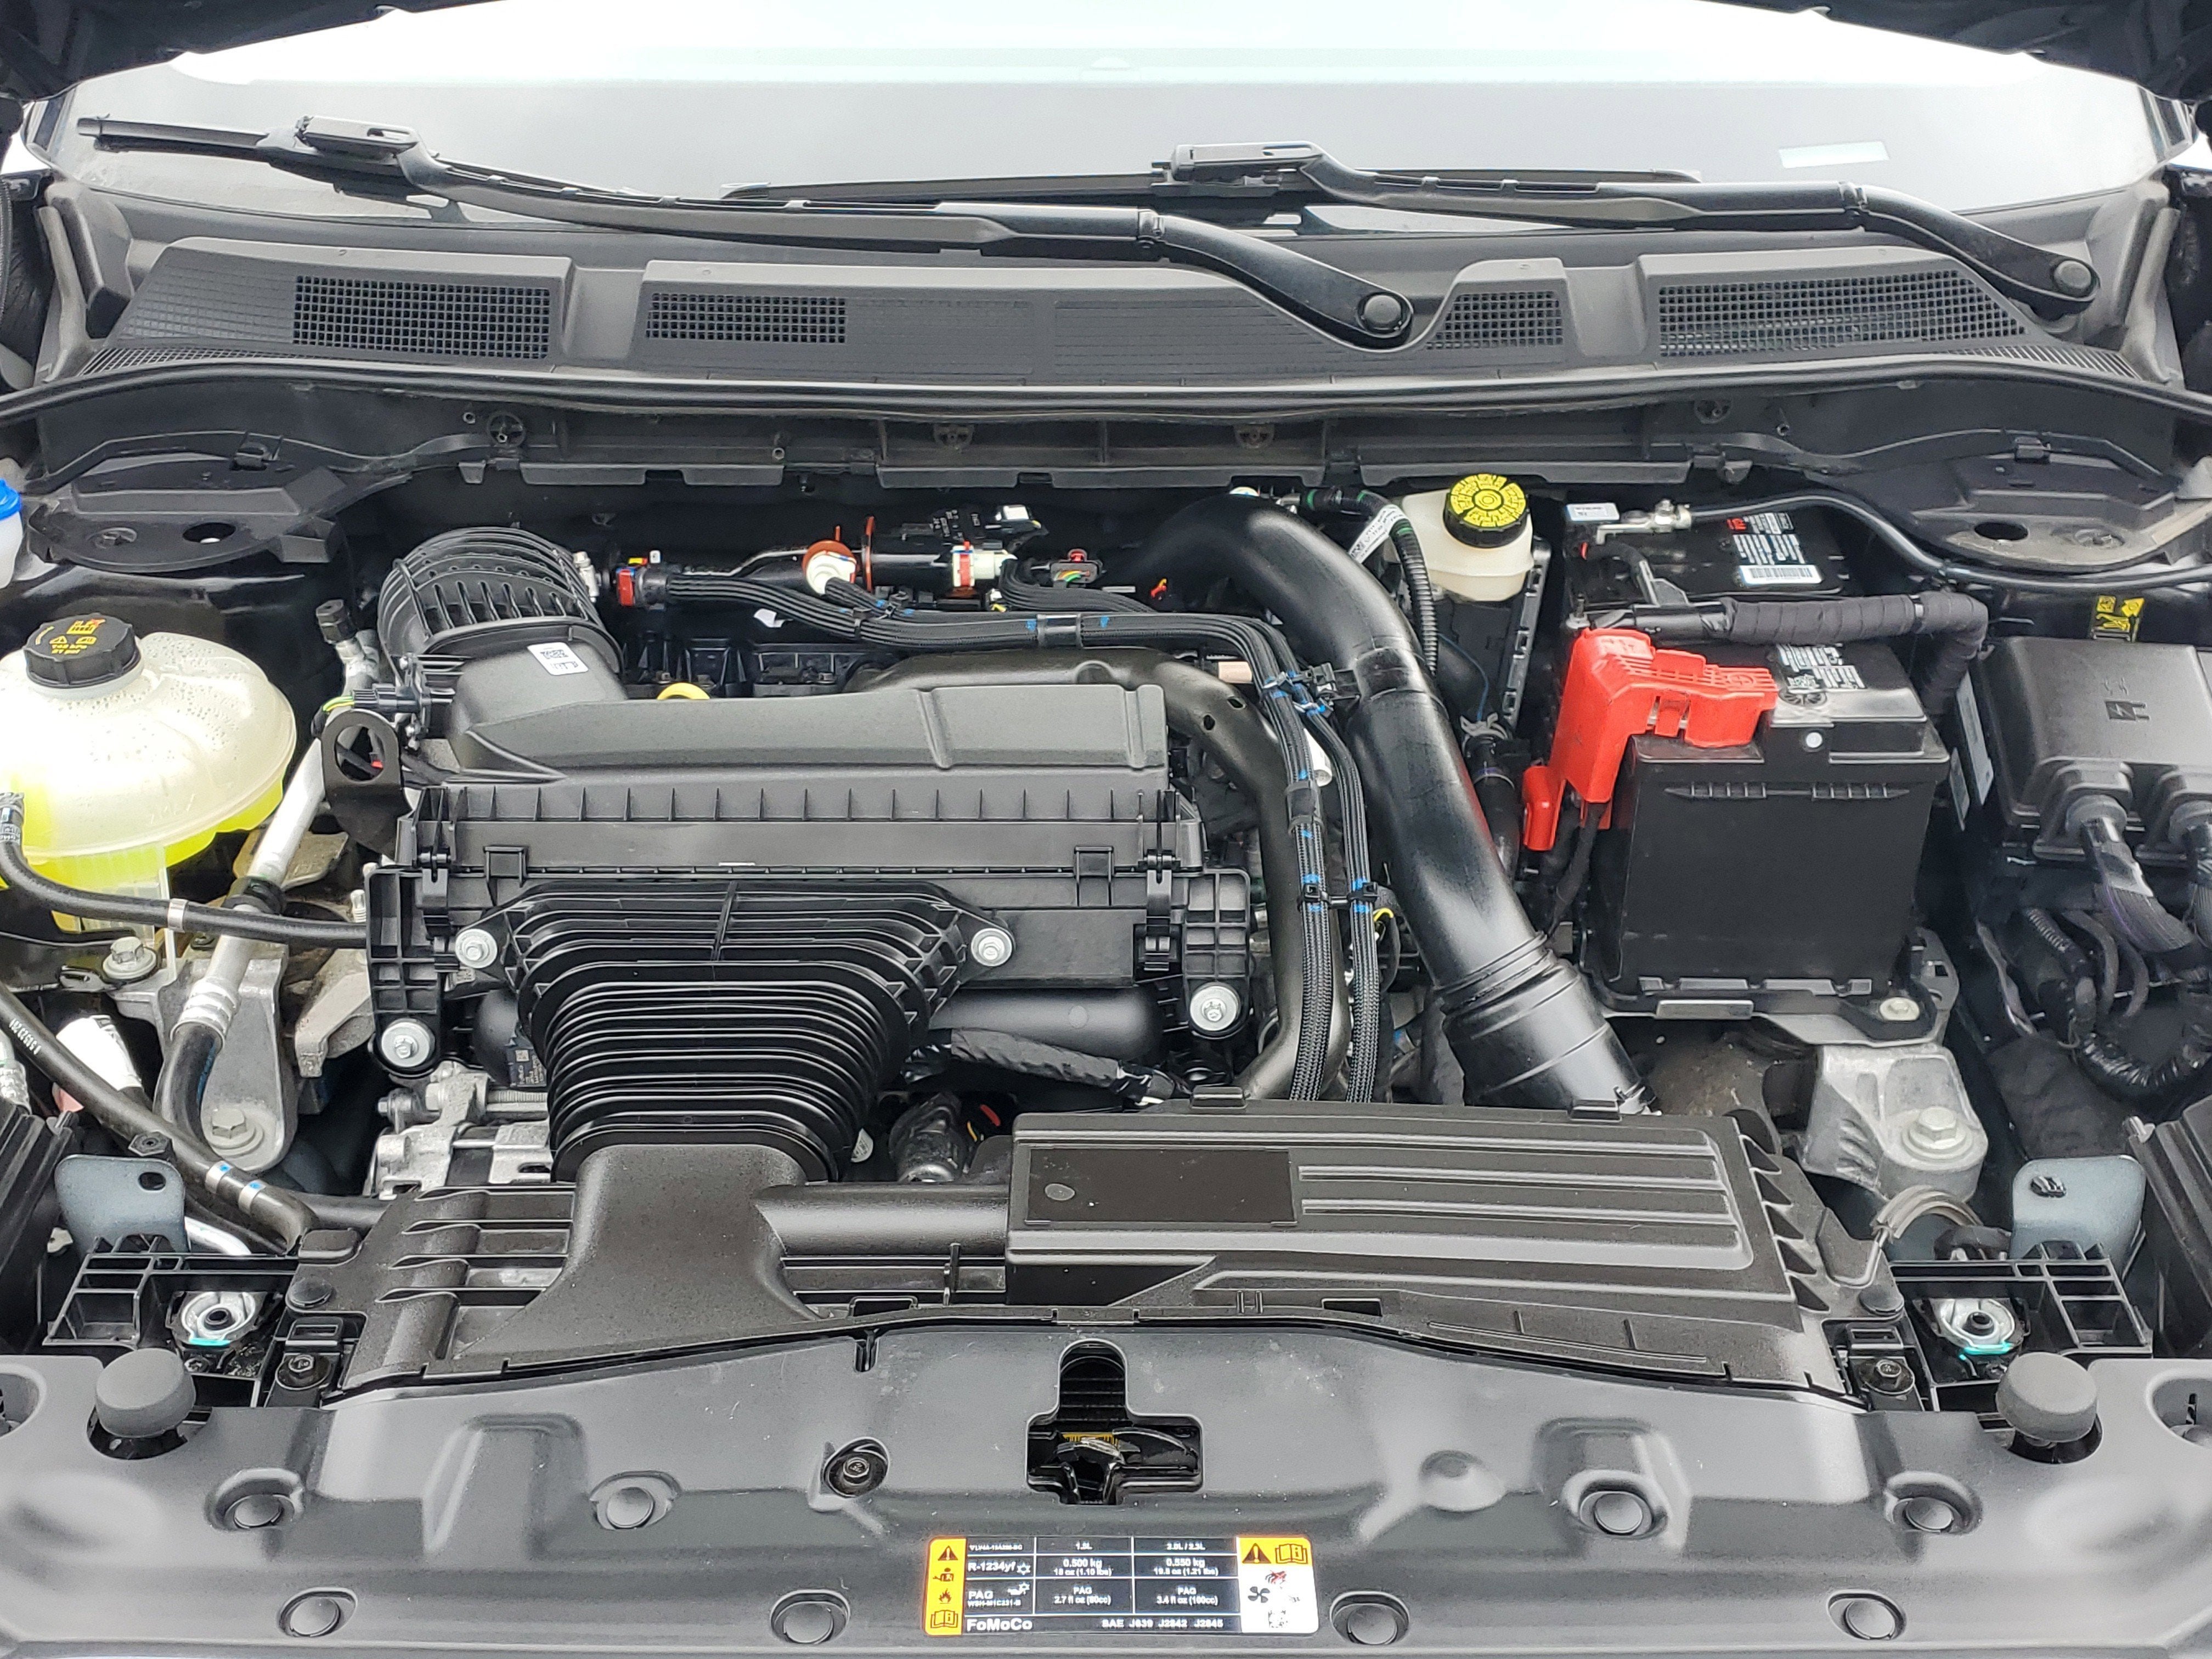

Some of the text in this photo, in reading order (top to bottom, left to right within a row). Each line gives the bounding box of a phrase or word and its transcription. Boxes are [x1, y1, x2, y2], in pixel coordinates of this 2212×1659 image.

[968, 1561, 1016, 1573] R-1234yf
[1063, 1558, 1103, 1571] 0.500 kg
[1193, 1558, 1206, 1568] kg
[968, 1590, 994, 1600] PAG
[1073, 1587, 1093, 1595] PAG
[1177, 1587, 1197, 1595] PAG
[1054, 1595, 1067, 1604] 2.7
[967, 1618, 1033, 1632] FoMoCo
